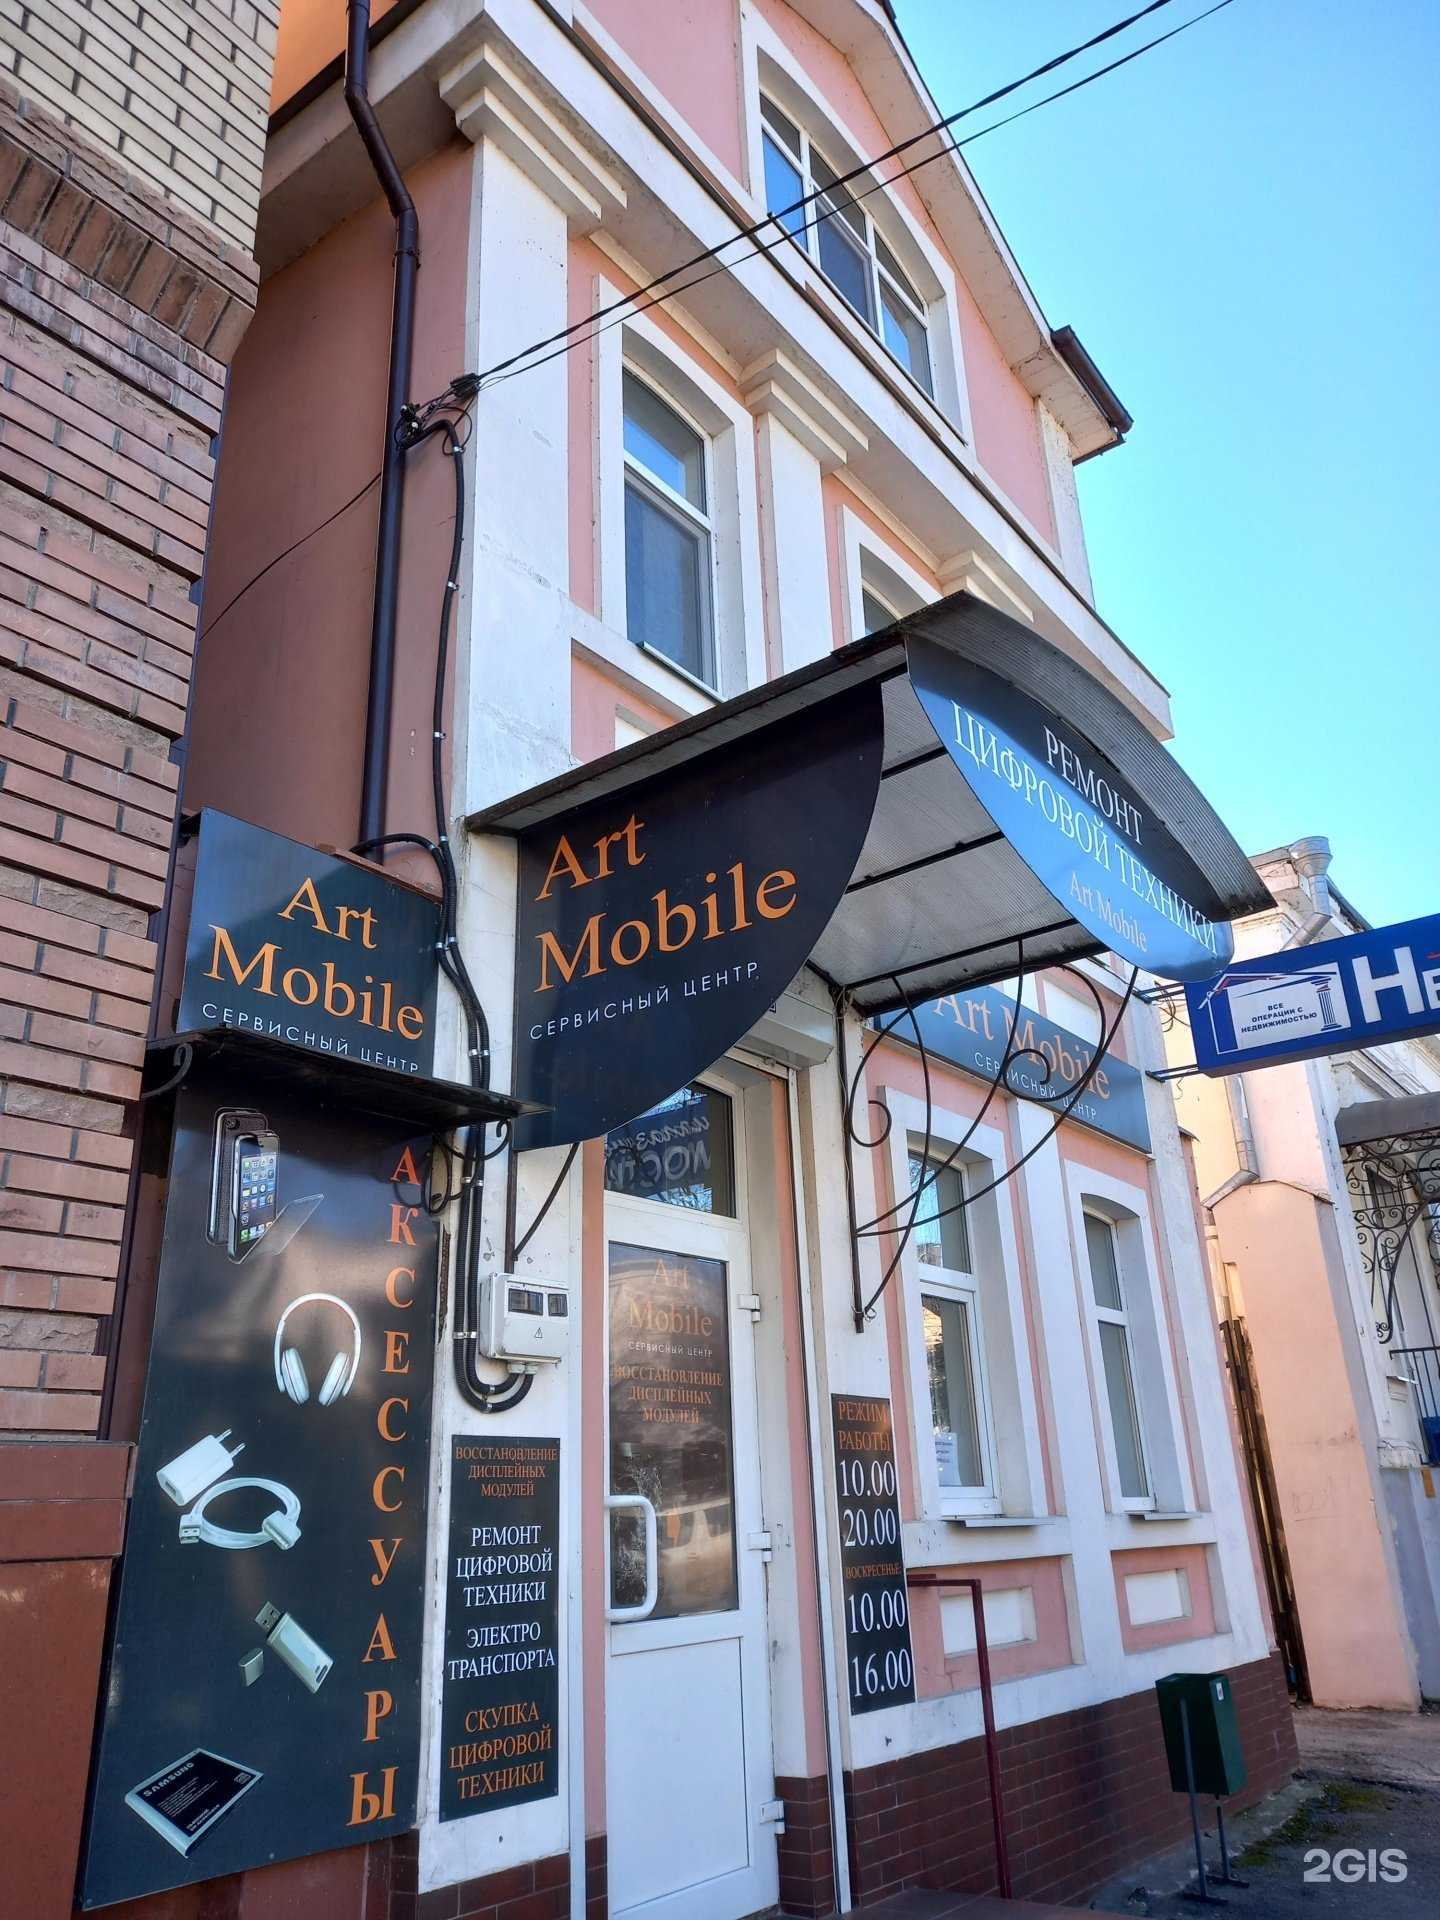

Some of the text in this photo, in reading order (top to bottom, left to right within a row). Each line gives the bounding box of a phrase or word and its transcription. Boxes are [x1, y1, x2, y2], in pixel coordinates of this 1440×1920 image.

[1043, 726, 1144, 846] РЕМОНТ
[951, 699, 1218, 955] ЦИФРОВОЙ ТЕХНИКИ
[535, 814, 647, 901] Art
[277, 877, 379, 950] Art
[533, 862, 798, 993] Mobile
[1069, 870, 1148, 953] Art Mobile
[203, 923, 425, 1041] Mobile
[529, 961, 760, 1041] СЕРВИСНЫЙ ЦЕНТР
[1251, 1007, 1296, 1024] ОПЕРАЦИИ
[1267, 1002, 1284, 1012] ВСЕ
[201, 1002, 420, 1074] СЕРВИСНЫЙ ЦЕНТР
[1240, 1011, 1318, 1034] НЕДВИЖИМОСТЬЮ
[934, 996, 1111, 1100] Art Mobile
[654, 1257, 689, 1290] Art
[628, 1295, 713, 1338] Mobile
[627, 1340, 713, 1358] СЕРВИСНЫЙ ЦЕНТР
[613, 1364, 724, 1387] ВОССТАНОВЛЕНИЕ
[628, 1384, 712, 1405] ДИСПЛЕЙНЫХ
[641, 1406, 701, 1425] МОДУЛЕЙ
[837, 1401, 888, 1424] РЕЖИМ
[455, 1446, 558, 1462] ВОССТАНОВЛЕНИЕ
[837, 1430, 891, 1452] РАБОТЫ
[345, 1145, 422, 1827] АКСЕССУАРЫ
[468, 1462, 546, 1480] ДИСПЛЕЙНЫХ
[839, 1459, 895, 1497] 10.00
[481, 1480, 535, 1498] МОДУЛЕЙ
[470, 1525, 542, 1547] РЕМОНТ
[842, 1507, 897, 1547] 20.00
[455, 1547, 553, 1583] ЦИФРОВОЙ
[463, 1581, 546, 1608] ТЕХНИКИ
[848, 1589, 906, 1634] 10.00
[466, 1621, 541, 1649] ЭЛЕКТРО
[447, 1647, 556, 1681] ТРАНСПОРТА
[851, 1648, 911, 1698] 16.00
[464, 1701, 540, 1734] СКУПКА
[448, 1723, 553, 1772] ЦИФРОВОЙ
[143, 1762, 194, 1797] SAMSUNG
[457, 1760, 545, 1800] ТЕХНИКИ
